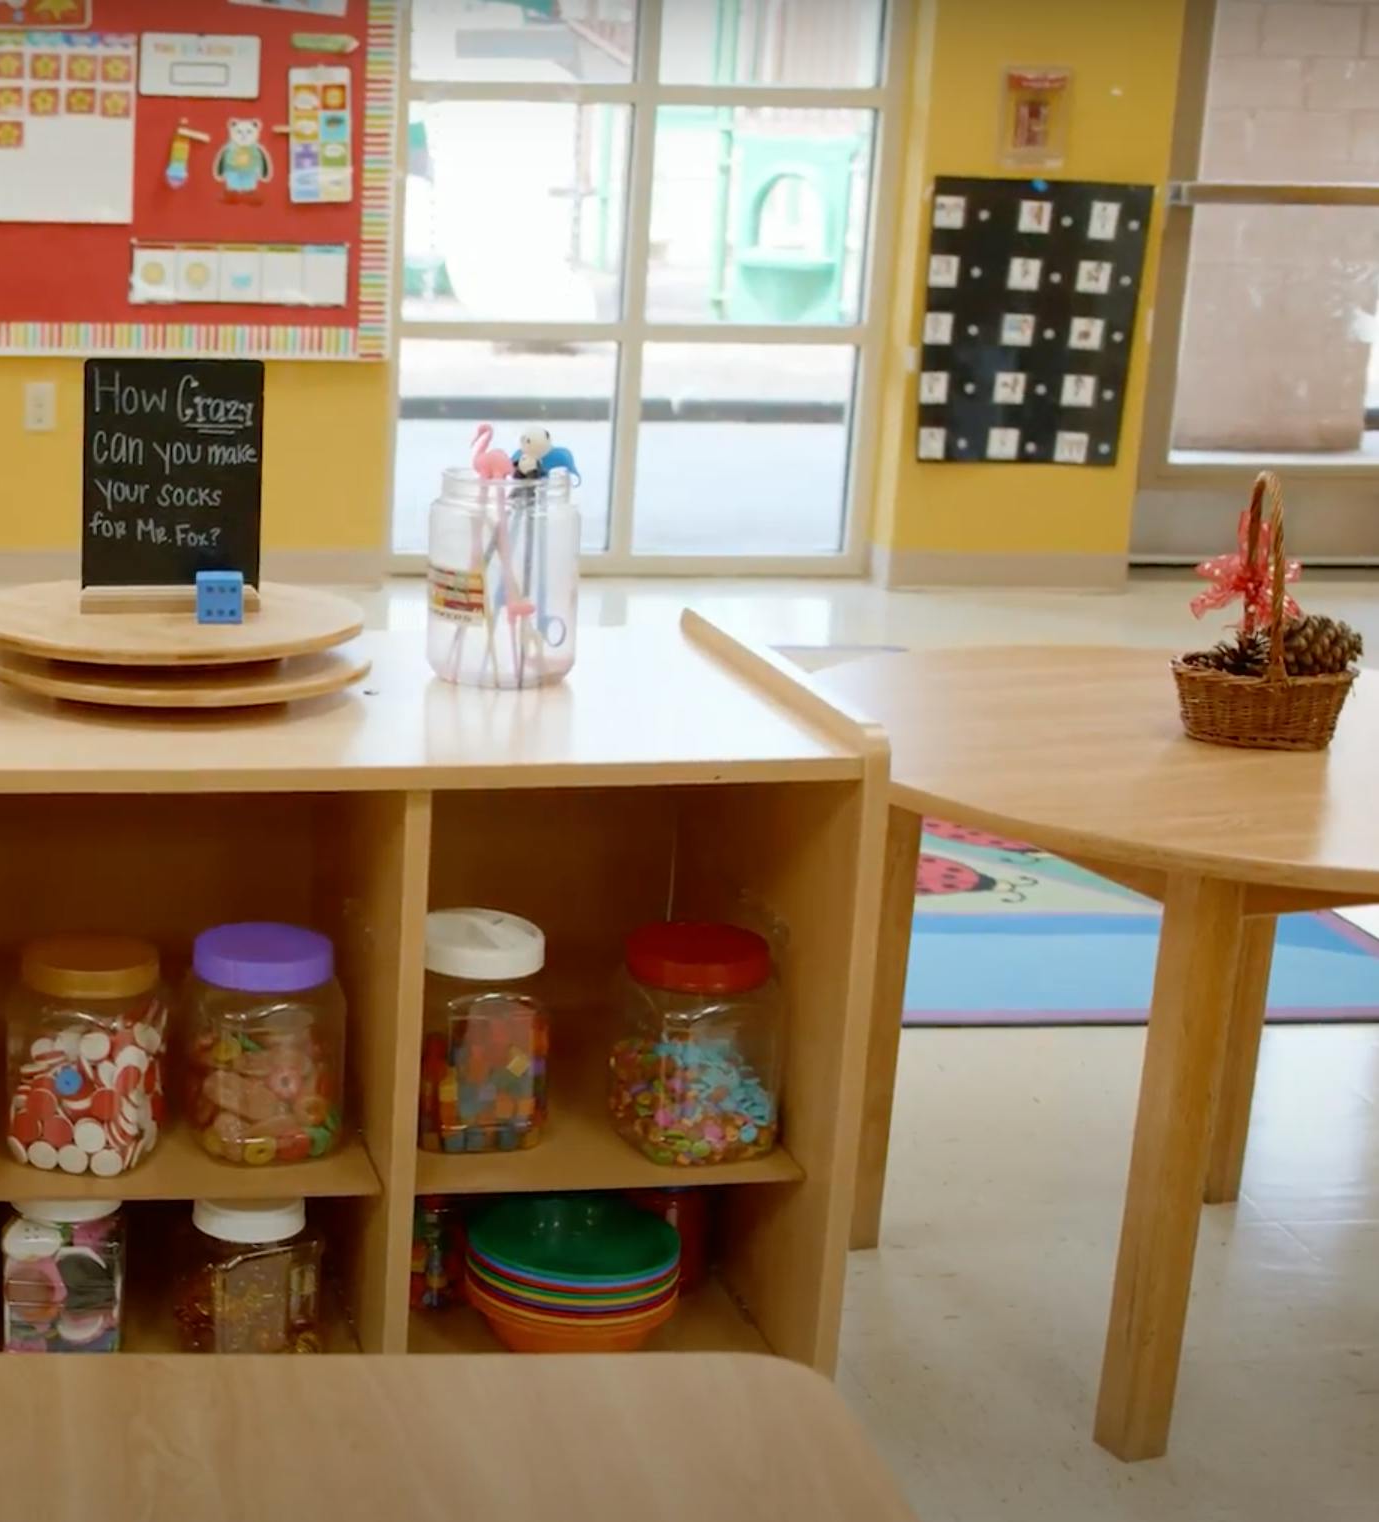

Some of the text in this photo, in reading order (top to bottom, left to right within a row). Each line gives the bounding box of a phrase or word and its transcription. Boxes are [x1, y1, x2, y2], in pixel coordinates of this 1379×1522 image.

[93, 367, 254, 427] How Crazy
[92, 430, 258, 476] can you make
[94, 478, 223, 512] your socks
[175, 523, 221, 547] Fox?
